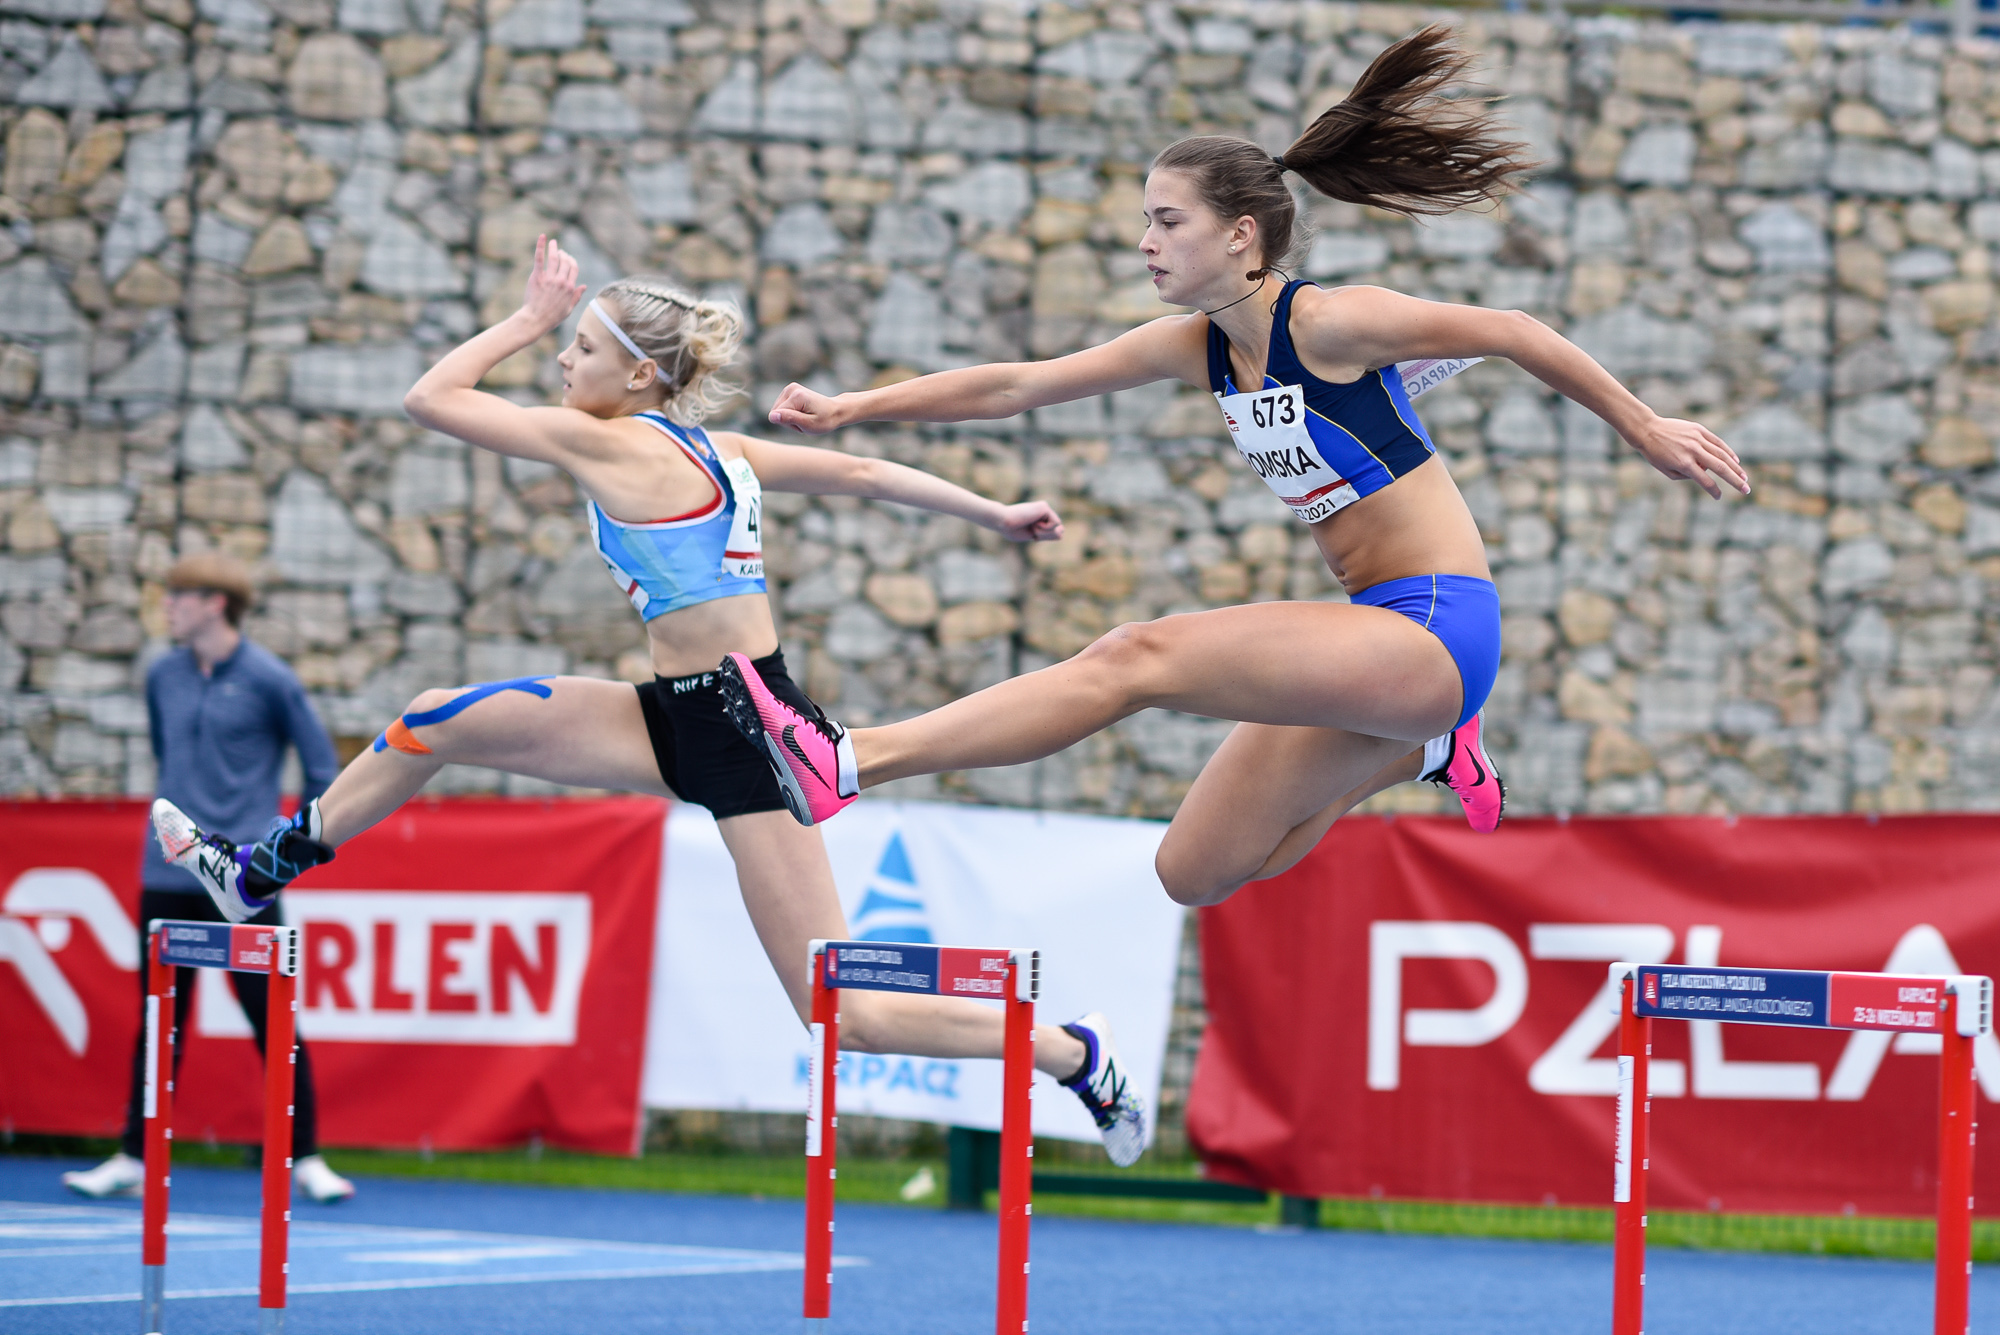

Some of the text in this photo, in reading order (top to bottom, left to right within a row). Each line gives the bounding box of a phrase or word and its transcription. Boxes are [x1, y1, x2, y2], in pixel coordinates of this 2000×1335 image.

[1252, 393, 1296, 428] 673
[1240, 446, 1321, 478] OMSKA
[1304, 498, 1336, 521] 2021
[226, 919, 559, 1016] RLEN
